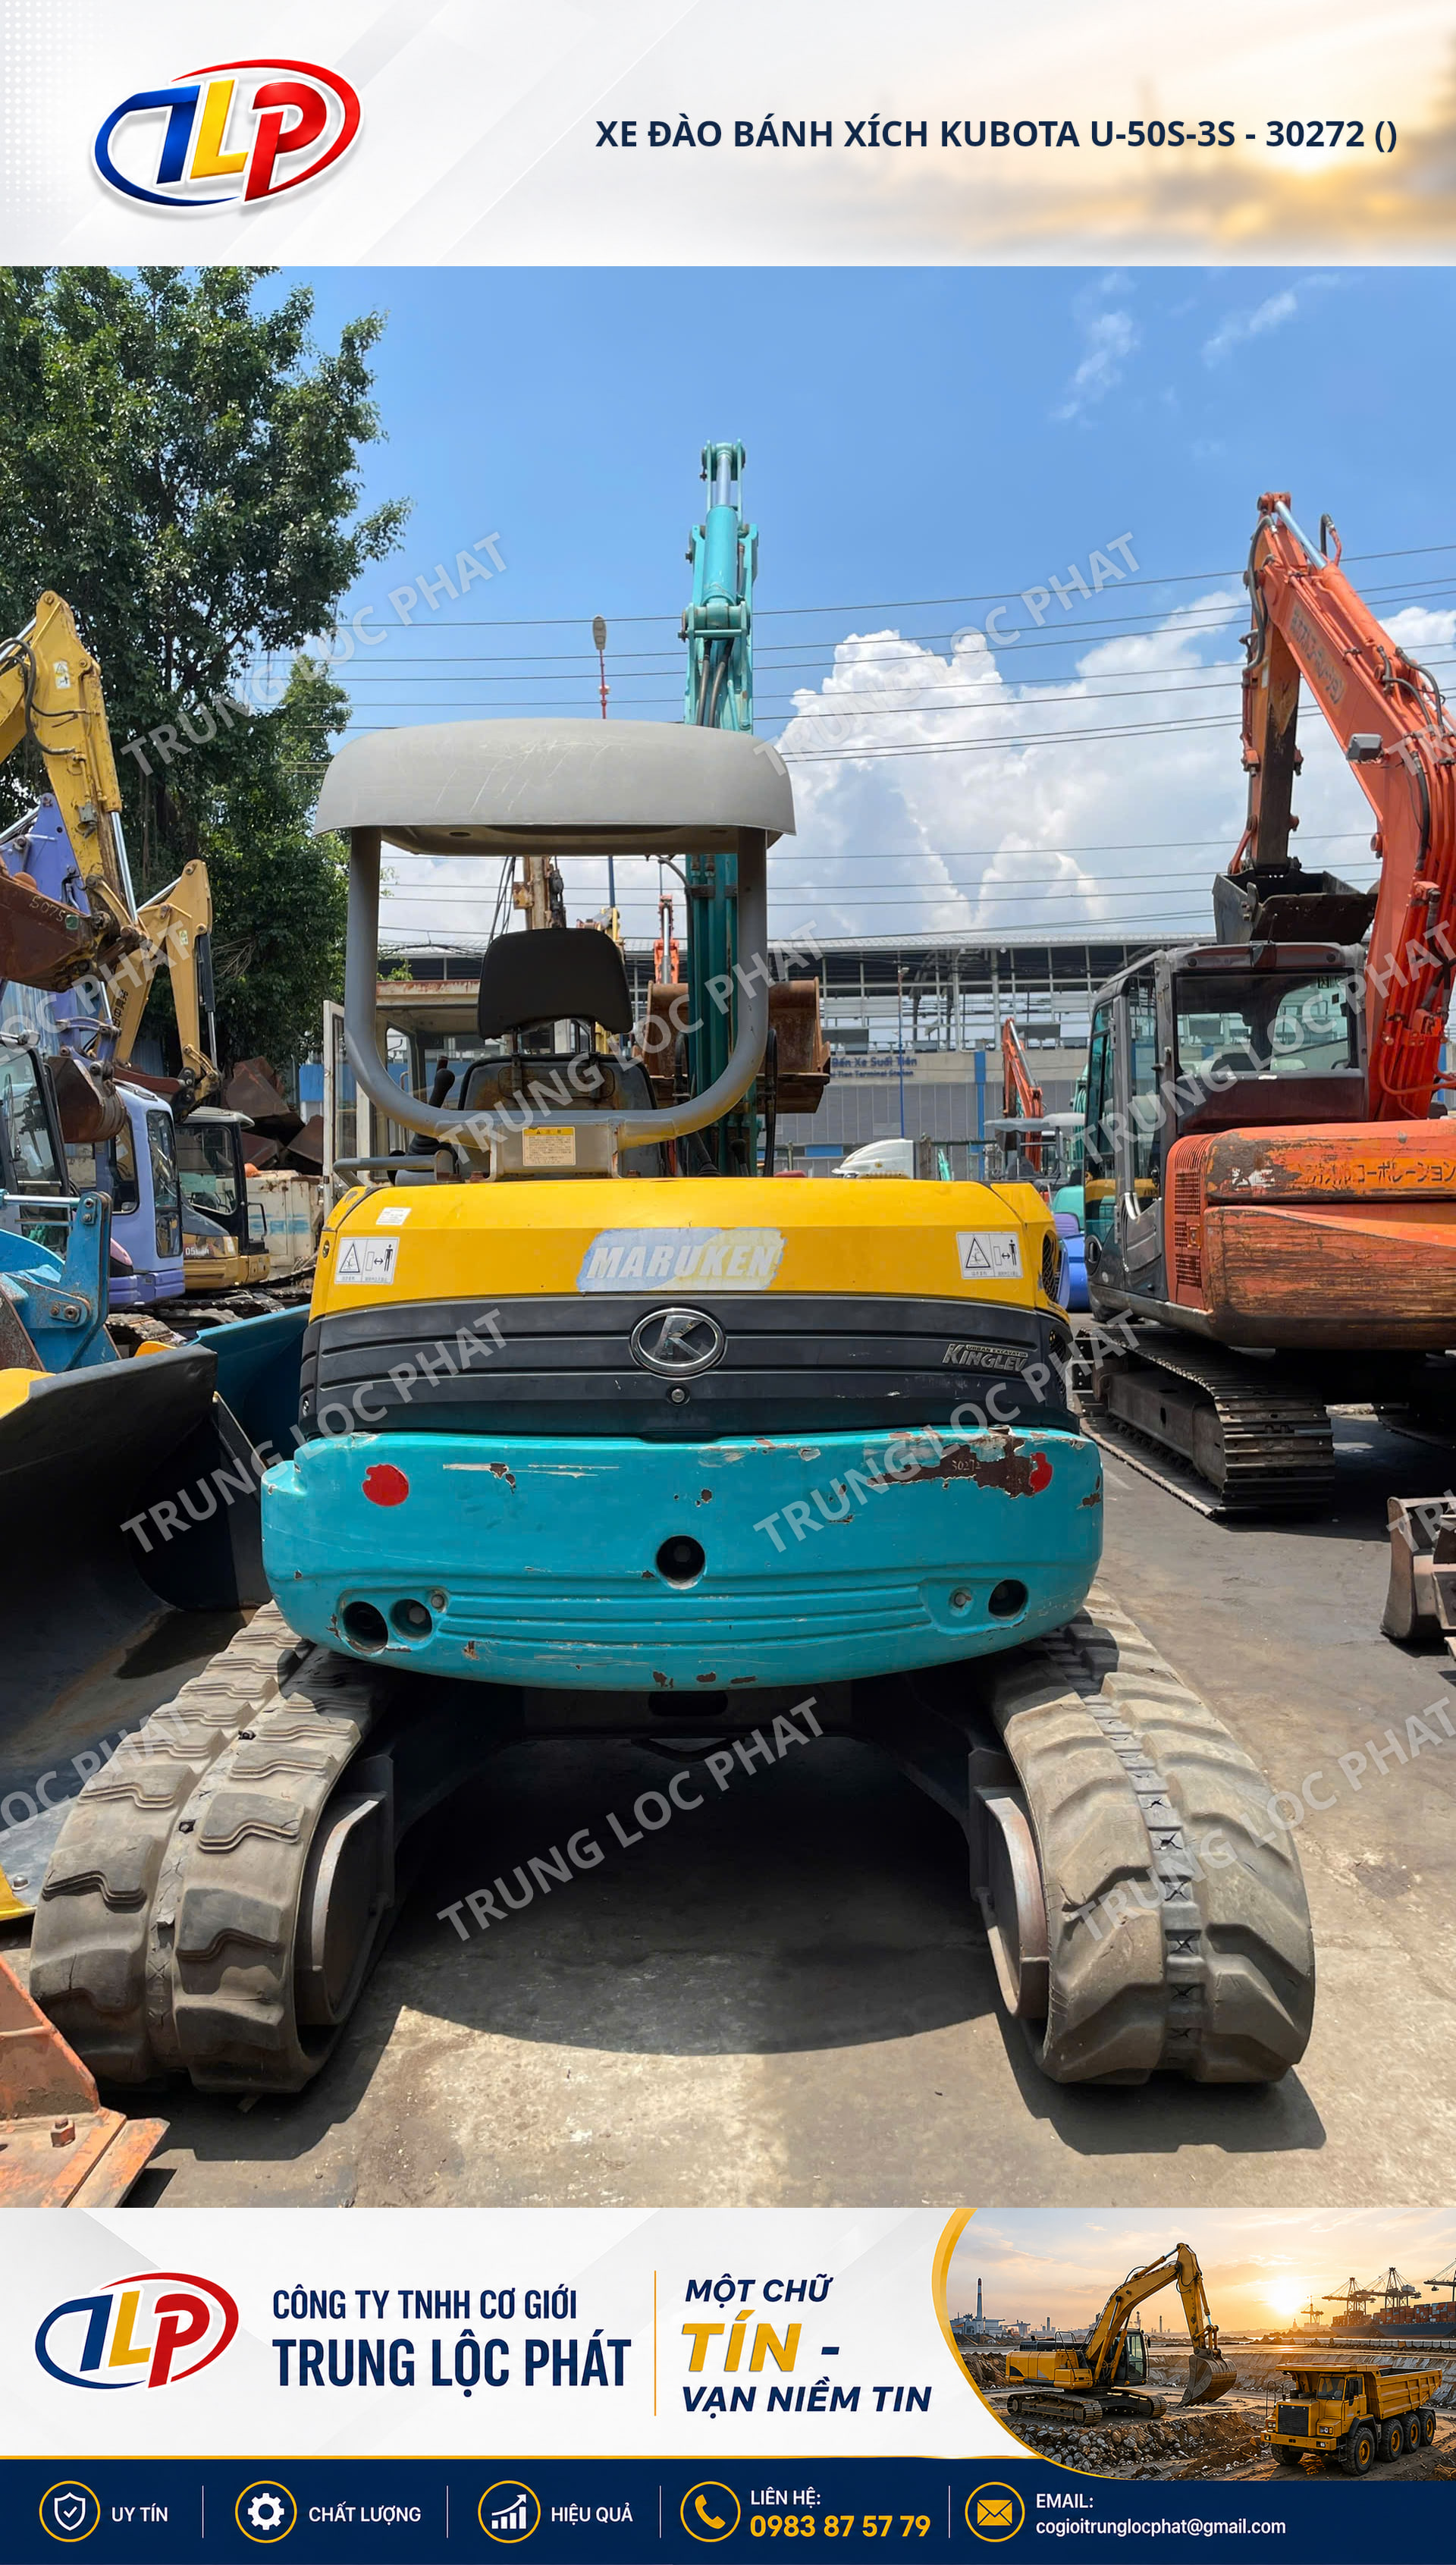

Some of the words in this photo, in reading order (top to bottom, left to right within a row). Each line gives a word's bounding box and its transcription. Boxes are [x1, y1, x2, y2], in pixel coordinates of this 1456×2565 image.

[29, 896, 67, 922] 5075
[586, 1244, 777, 1279] MARUKEN
[942, 1343, 1028, 1372] KINGLEV
[992, 1348, 1028, 1358] EXCAVATOR
